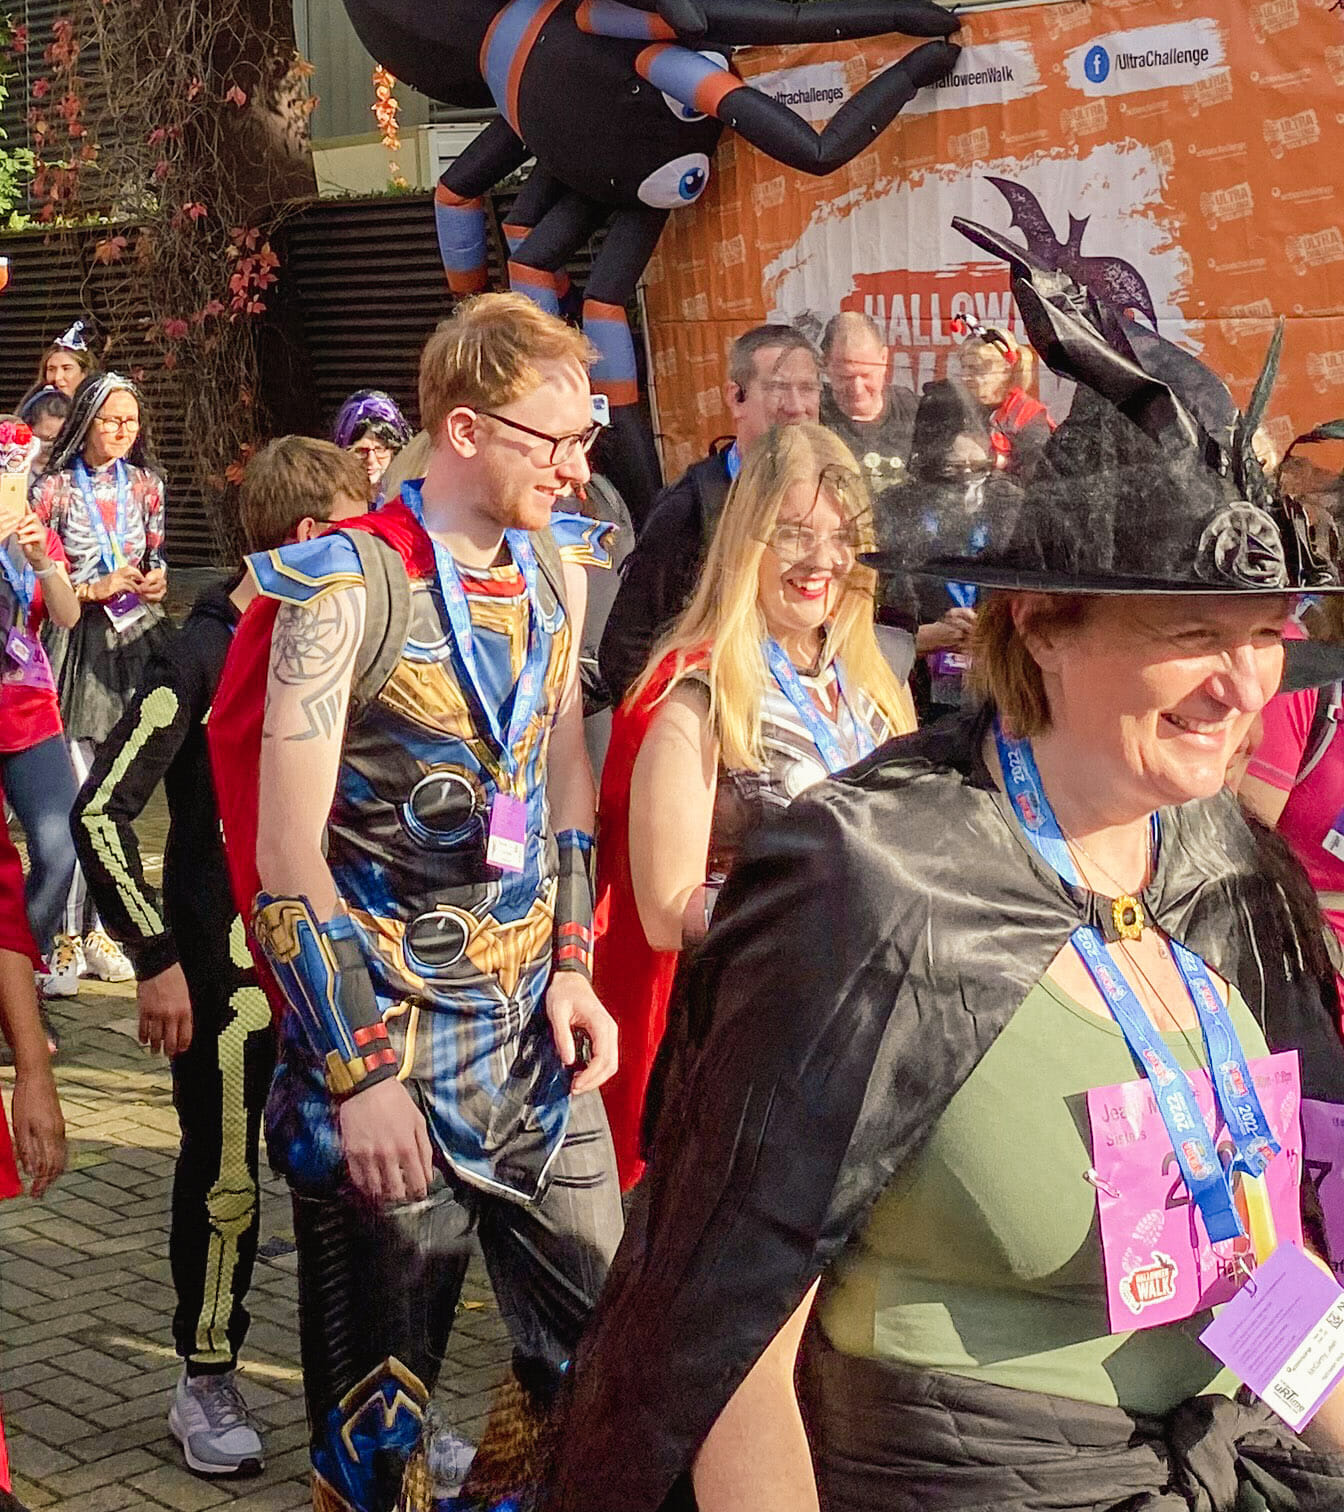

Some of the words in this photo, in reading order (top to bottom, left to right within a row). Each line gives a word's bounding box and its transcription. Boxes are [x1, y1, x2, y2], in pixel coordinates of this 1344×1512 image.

[1114, 46, 1209, 73] /UltraChallenge
[929, 65, 1015, 89] alloweenWalk
[1137, 1276, 1171, 1300] WALK
